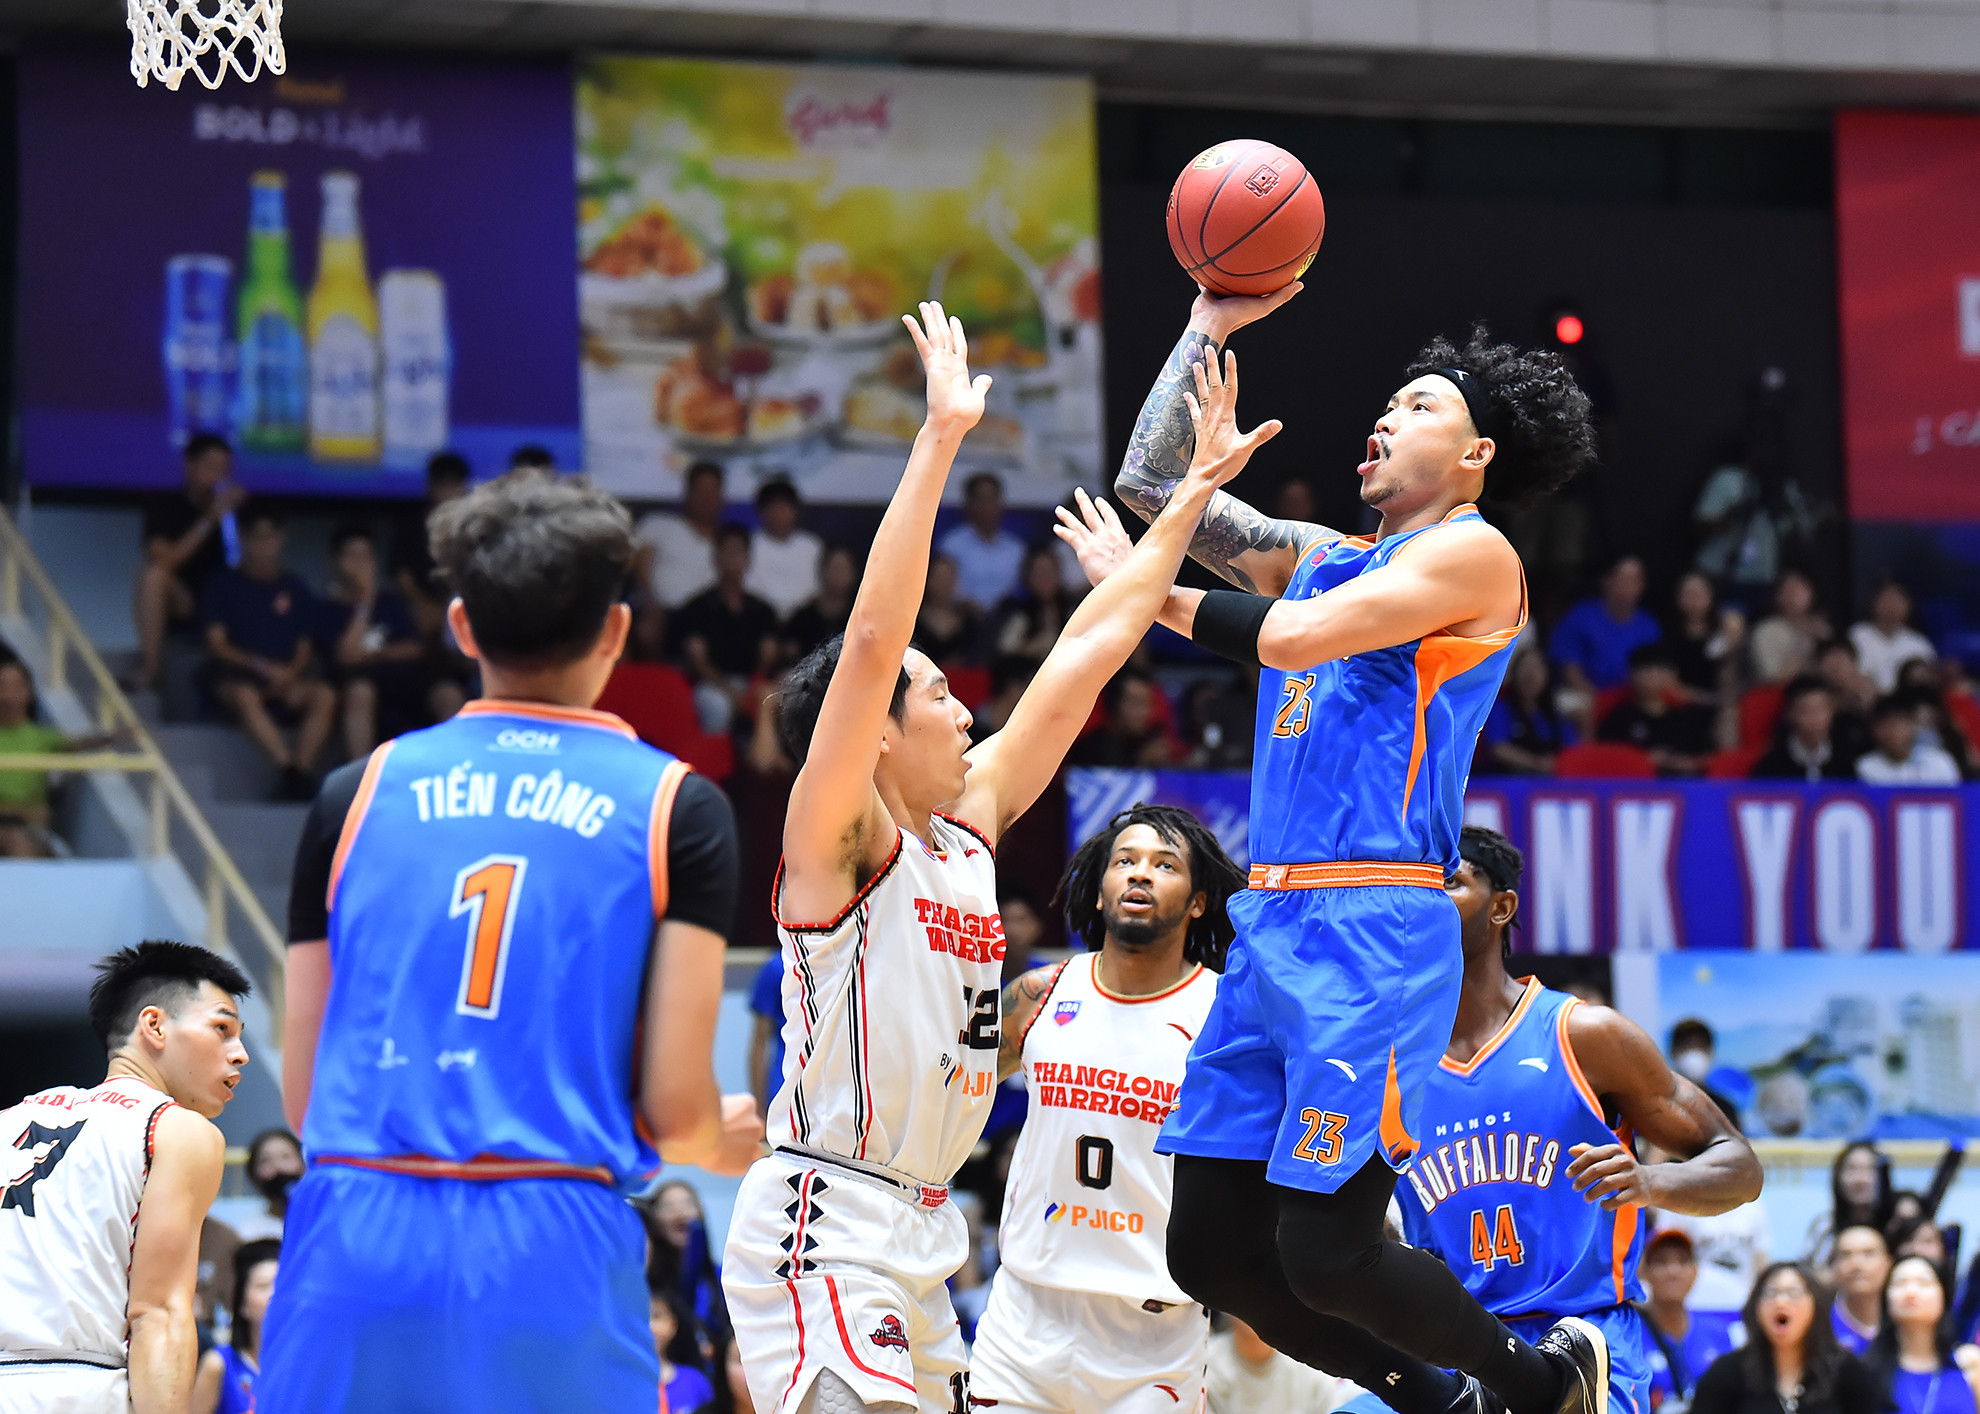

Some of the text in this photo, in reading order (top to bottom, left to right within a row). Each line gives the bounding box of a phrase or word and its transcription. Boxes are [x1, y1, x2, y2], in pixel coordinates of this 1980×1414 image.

[409, 759, 616, 839] TIẾN CÔNG
[1736, 801, 1958, 955] YOU
[448, 853, 529, 1020] 1
[940, 1053, 952, 1070] By
[1034, 1062, 1181, 1103] THANGLON
[0, 1120, 88, 1218] 7
[1075, 1134, 1114, 1191] 0
[1292, 1107, 1349, 1166] 23
[1407, 1131, 1561, 1216] BUFFALOES
[1071, 1205, 1144, 1234] PJICO
[1471, 1204, 1525, 1272] 44
